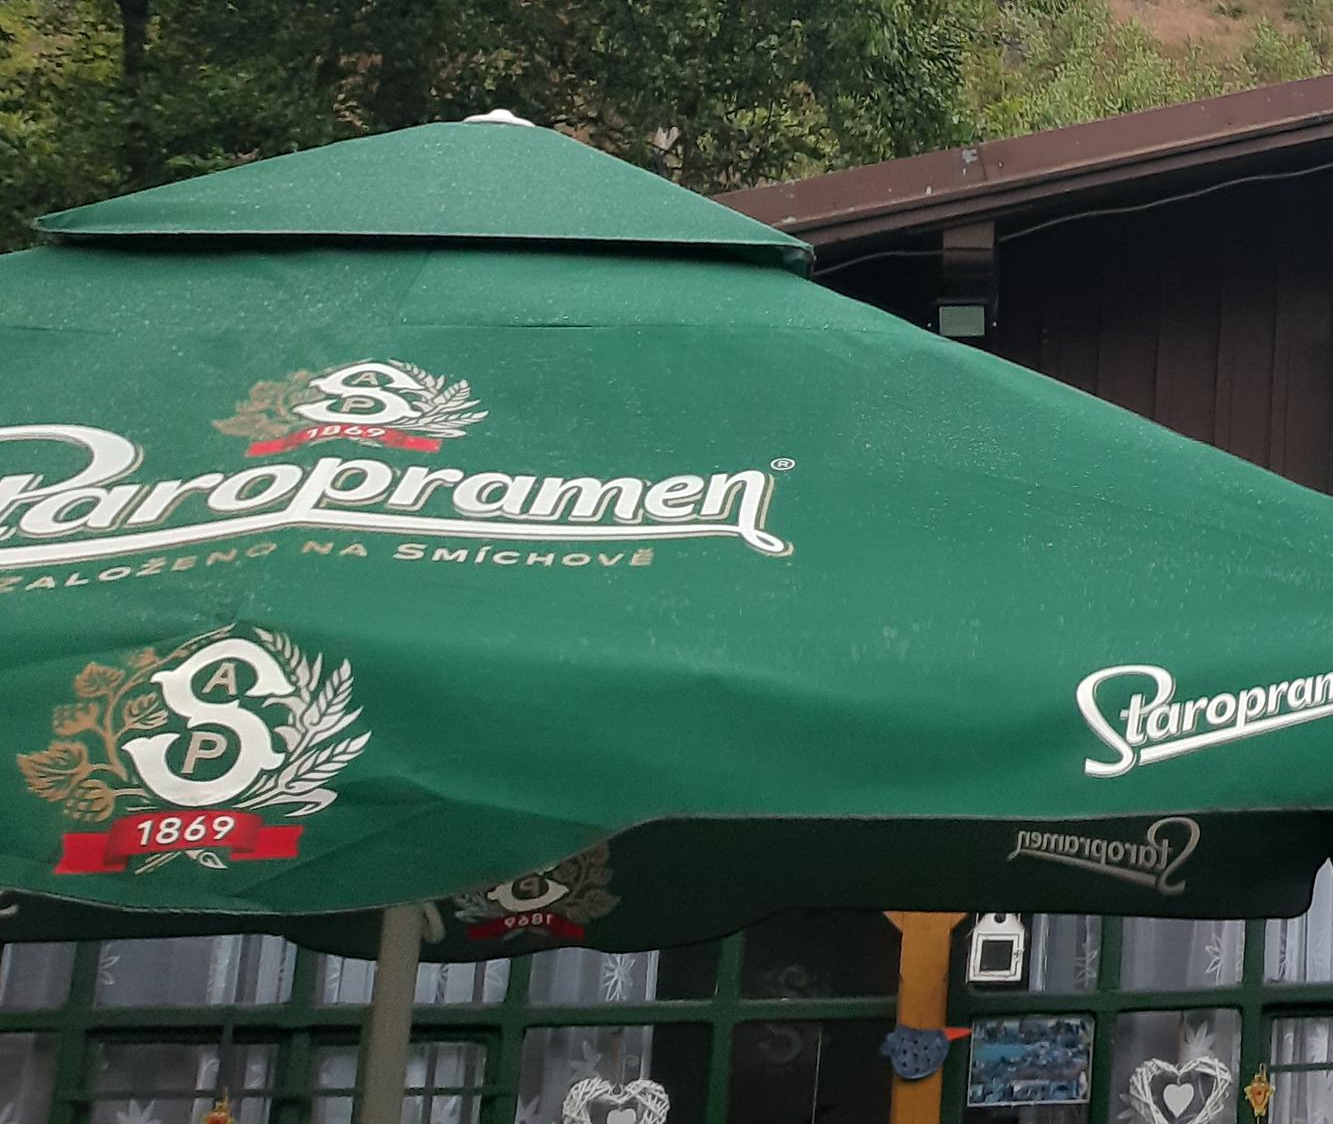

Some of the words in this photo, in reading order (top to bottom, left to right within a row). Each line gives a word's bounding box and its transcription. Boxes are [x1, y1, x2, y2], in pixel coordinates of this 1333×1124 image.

[306, 424, 387, 439] 1869
[301, 540, 369, 558] NA
[136, 815, 236, 847] 1869
